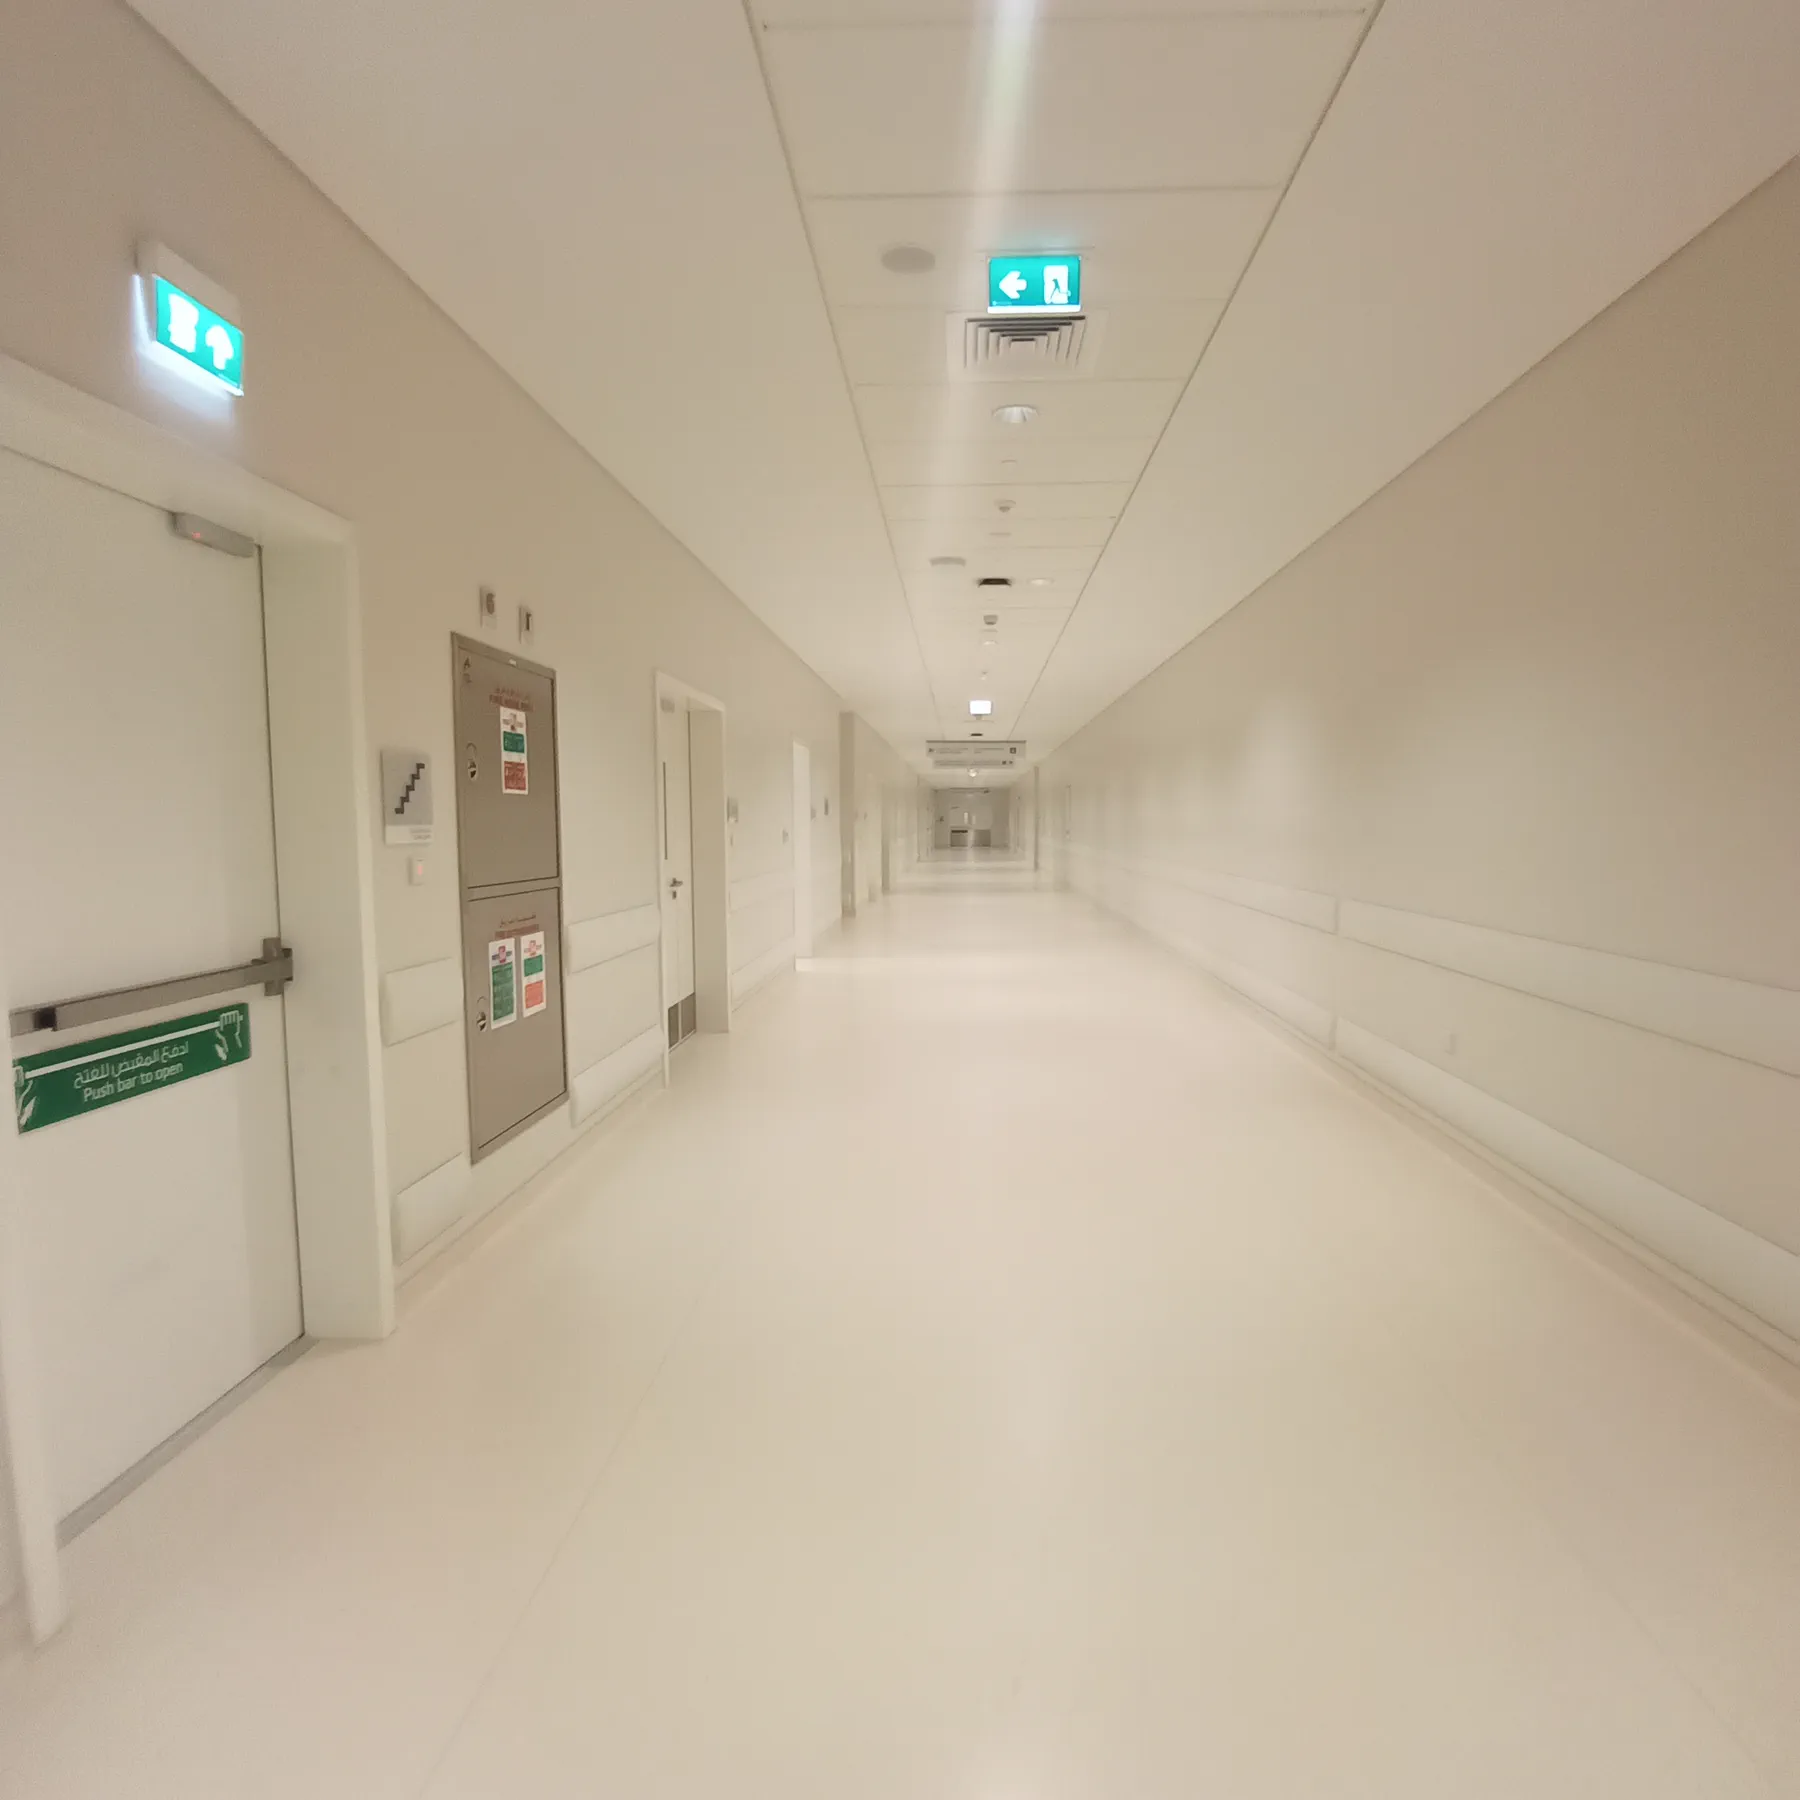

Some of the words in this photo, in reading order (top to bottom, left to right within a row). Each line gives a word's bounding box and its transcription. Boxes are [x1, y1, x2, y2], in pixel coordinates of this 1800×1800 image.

[111, 1050, 160, 1077] المقبض
[160, 1041, 189, 1063] ادفع
[74, 1063, 110, 1089] للفتح
[83, 1082, 115, 1102] Push
[117, 1077, 138, 1092] bar
[140, 1071, 154, 1084] to
[155, 1063, 184, 1081] open
